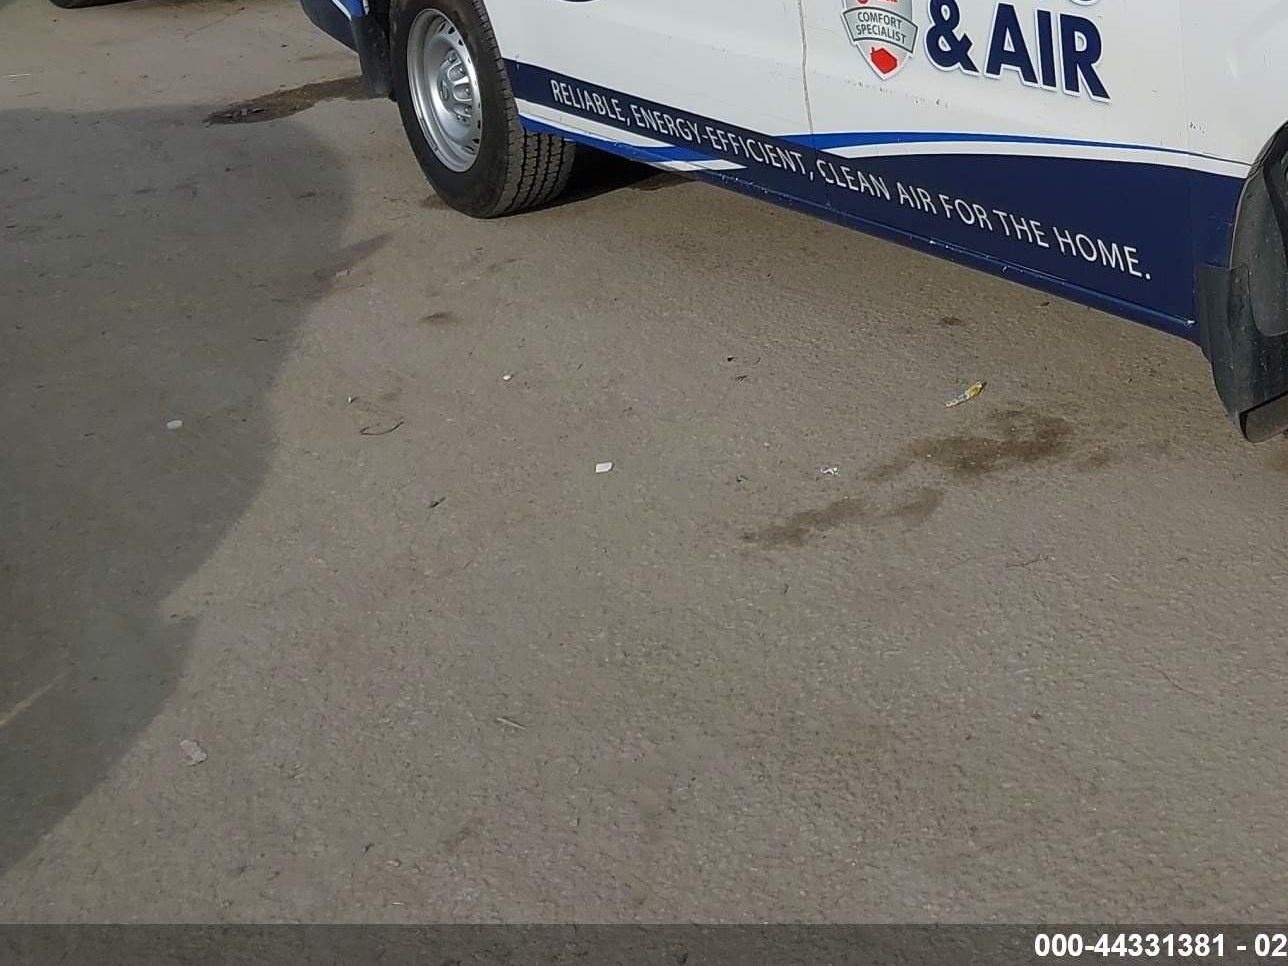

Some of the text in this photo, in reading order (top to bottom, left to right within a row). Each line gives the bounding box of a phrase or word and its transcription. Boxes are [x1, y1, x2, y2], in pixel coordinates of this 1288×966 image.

[856, 24, 907, 45] SPECIALIST
[857, 12, 902, 29] COMFORT
[986, 2, 1111, 101] AIR
[550, 80, 1153, 280] RELIABLE, ENERGY-EFFICIENT, CLEAN AIR FOR THE HOME.
